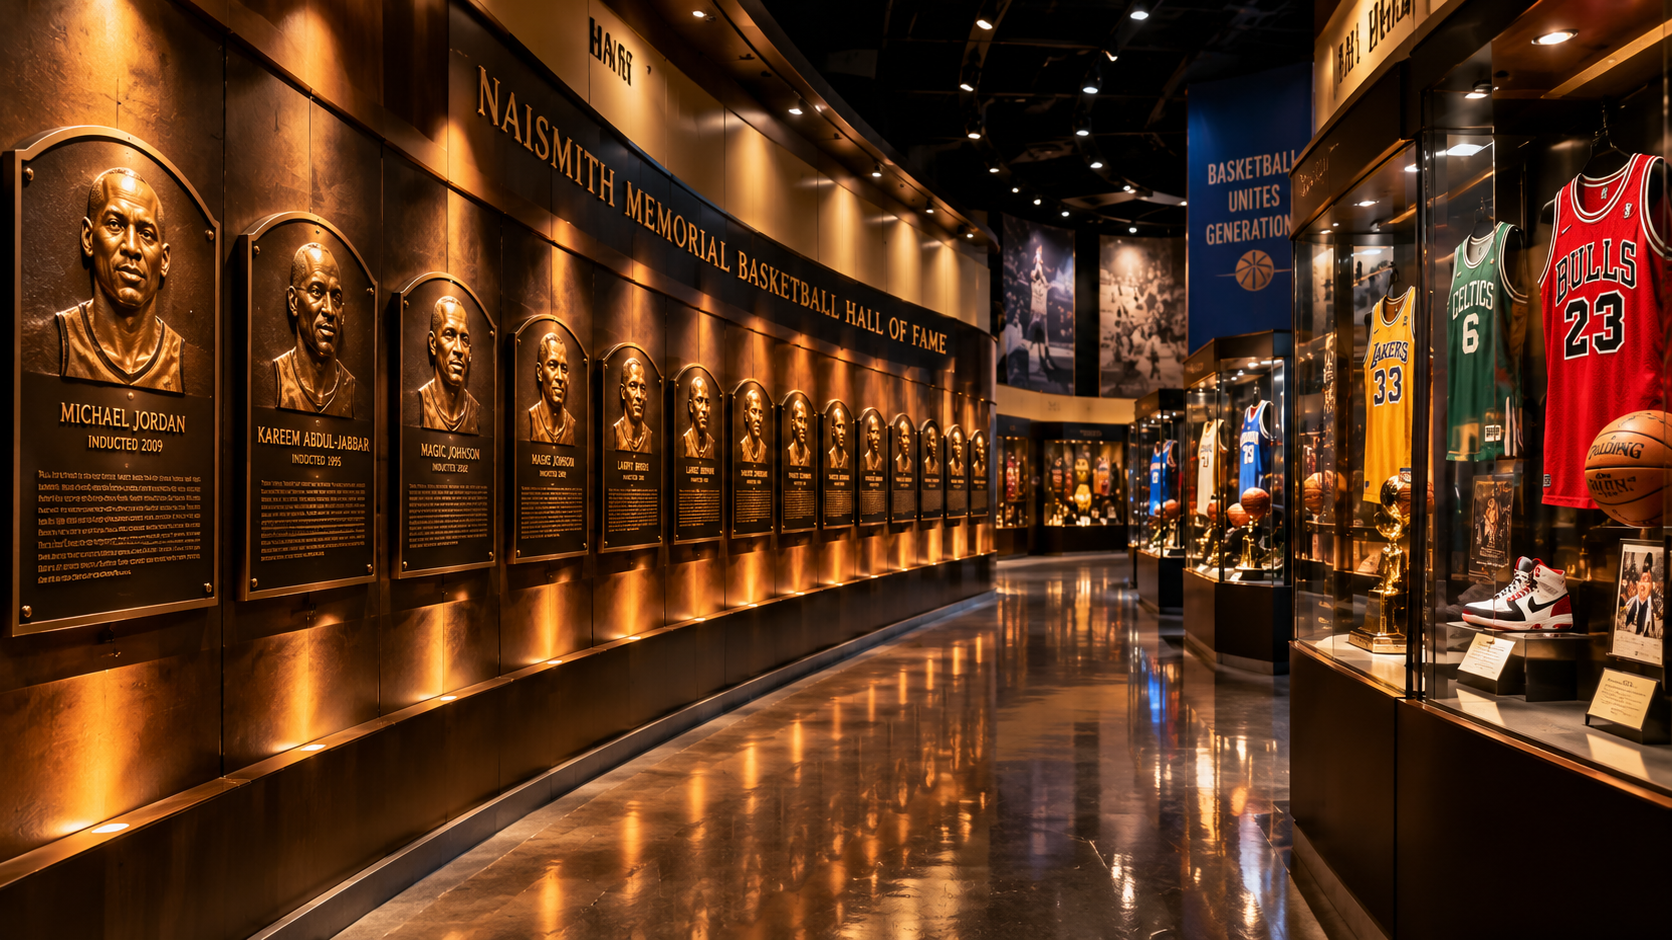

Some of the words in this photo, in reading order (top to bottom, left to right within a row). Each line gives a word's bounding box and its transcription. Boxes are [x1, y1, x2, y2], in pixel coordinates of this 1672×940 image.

[476, 65, 615, 208] NAISMITH
[625, 181, 730, 273] MEMORIAL
[737, 250, 840, 319] BASKETBALL
[845, 300, 884, 335] HALL
[889, 317, 907, 342] OF
[912, 324, 948, 355] FAME
[1228, 184, 1280, 212] UNITES
[1556, 238, 1637, 307] BULLS
[1453, 280, 1494, 320] CELTICS
[1462, 313, 1479, 354] 6
[1564, 290, 1625, 360] 23
[1370, 341, 1409, 370] LAKERS
[1373, 366, 1403, 406] 33
[60, 402, 129, 427] MICHAEL
[133, 410, 186, 433] JORDAN
[88, 435, 138, 451] INDUCTED
[141, 439, 163, 452] 2009
[257, 426, 300, 446] KAREEM
[303, 432, 370, 452] ABDUL-JABBAR
[420, 443, 447, 458] MAGIC
